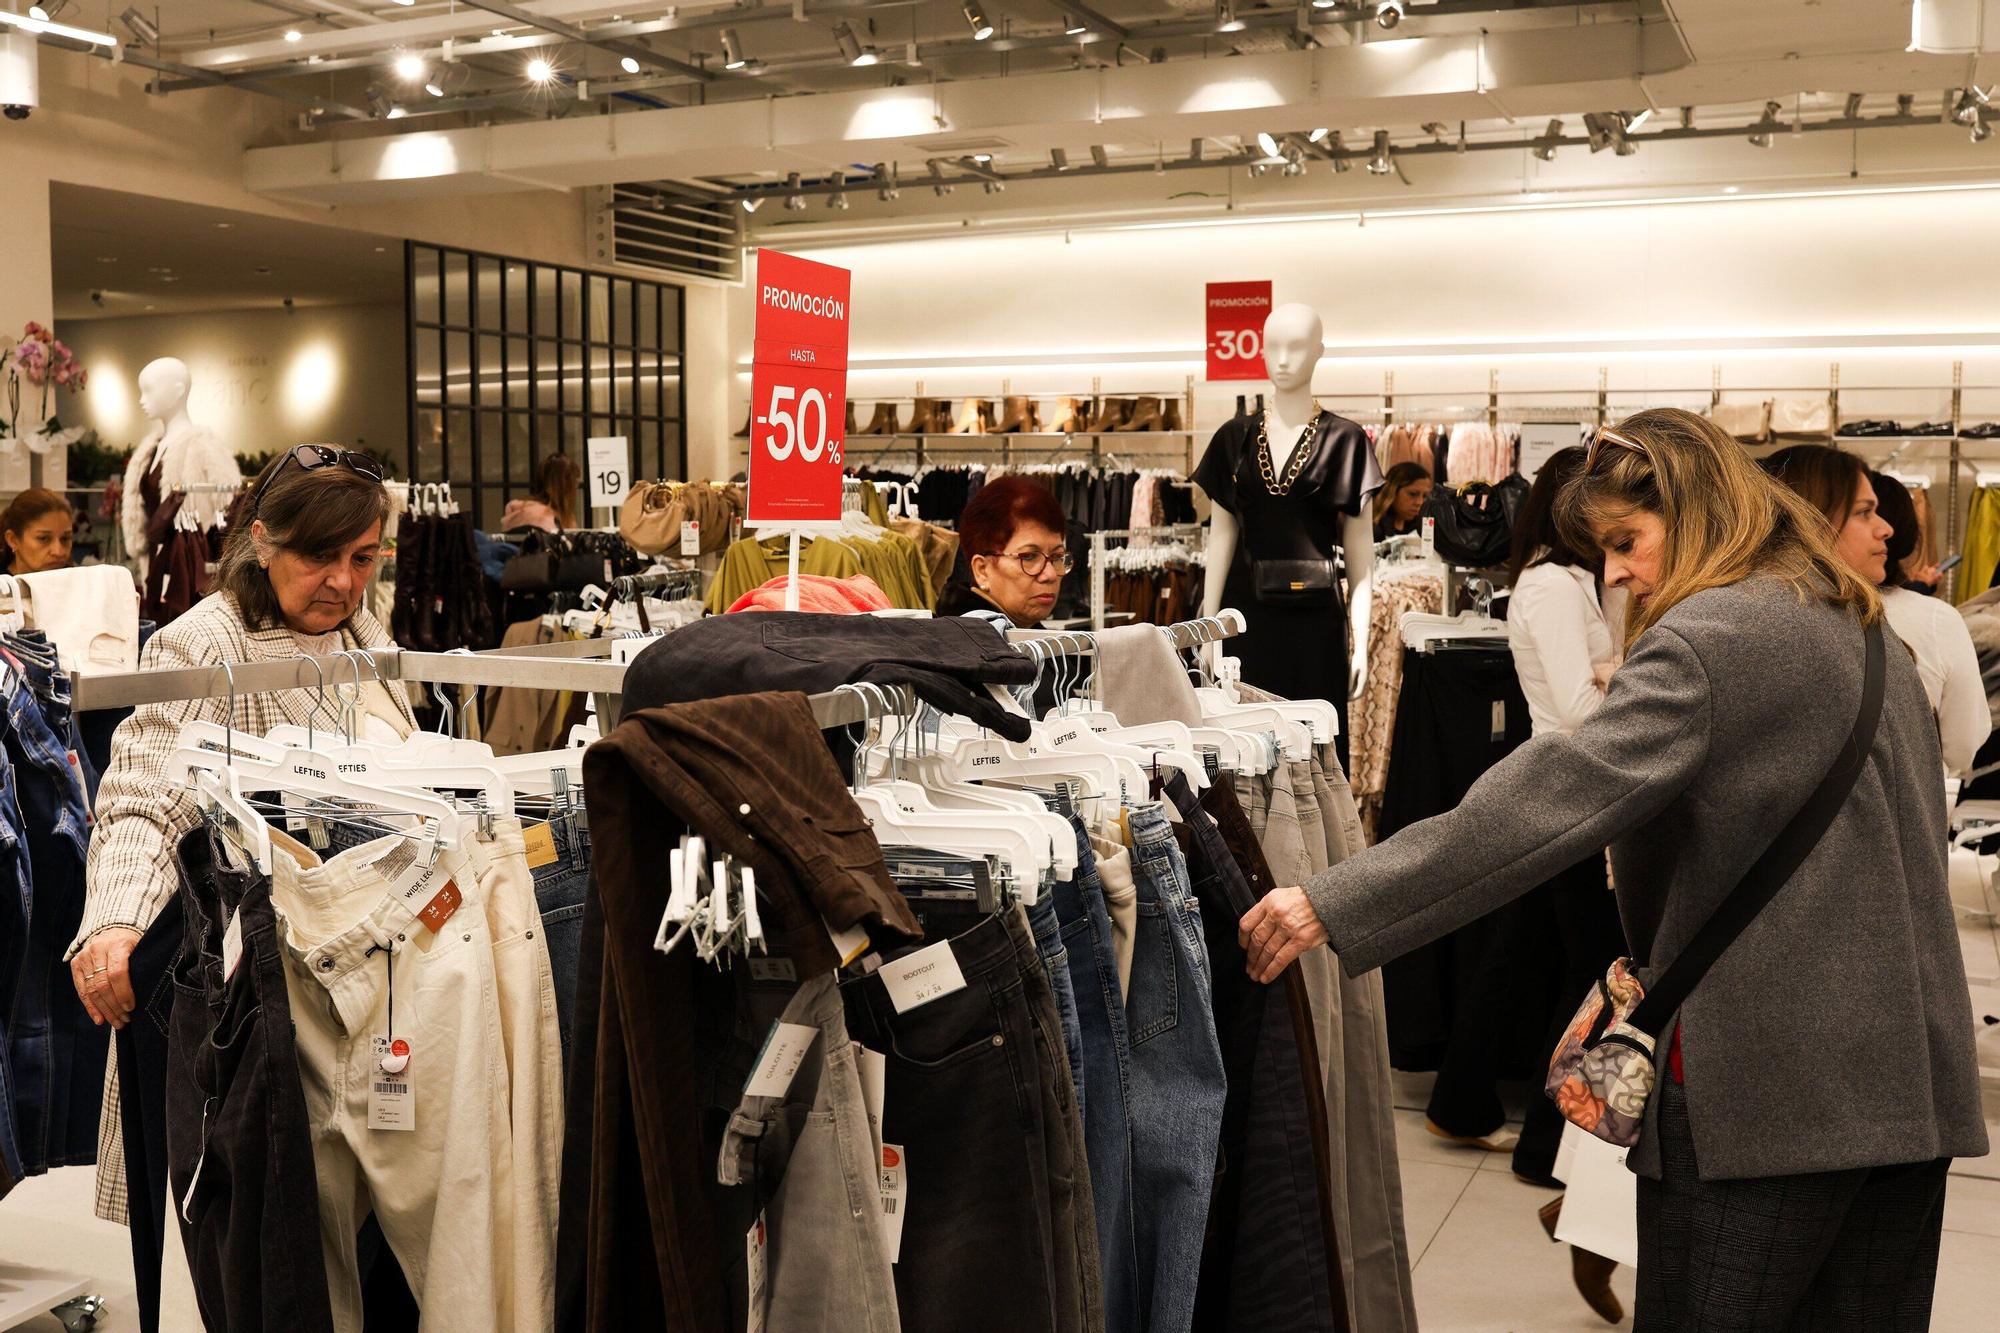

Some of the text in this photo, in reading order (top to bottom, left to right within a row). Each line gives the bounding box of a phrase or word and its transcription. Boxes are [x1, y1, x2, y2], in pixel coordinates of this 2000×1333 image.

[763, 285, 844, 321] PROMOCIÓN
[790, 348, 816, 363] HASTA
[1054, 731, 1078, 746] LEFTIES
[338, 764, 367, 773] EFTIES
[972, 756, 1001, 766] LEFTIES
[294, 765, 326, 780] LEFTIES
[404, 869, 434, 899] WIDE LEG
[902, 963, 936, 981] BOOTCUT
